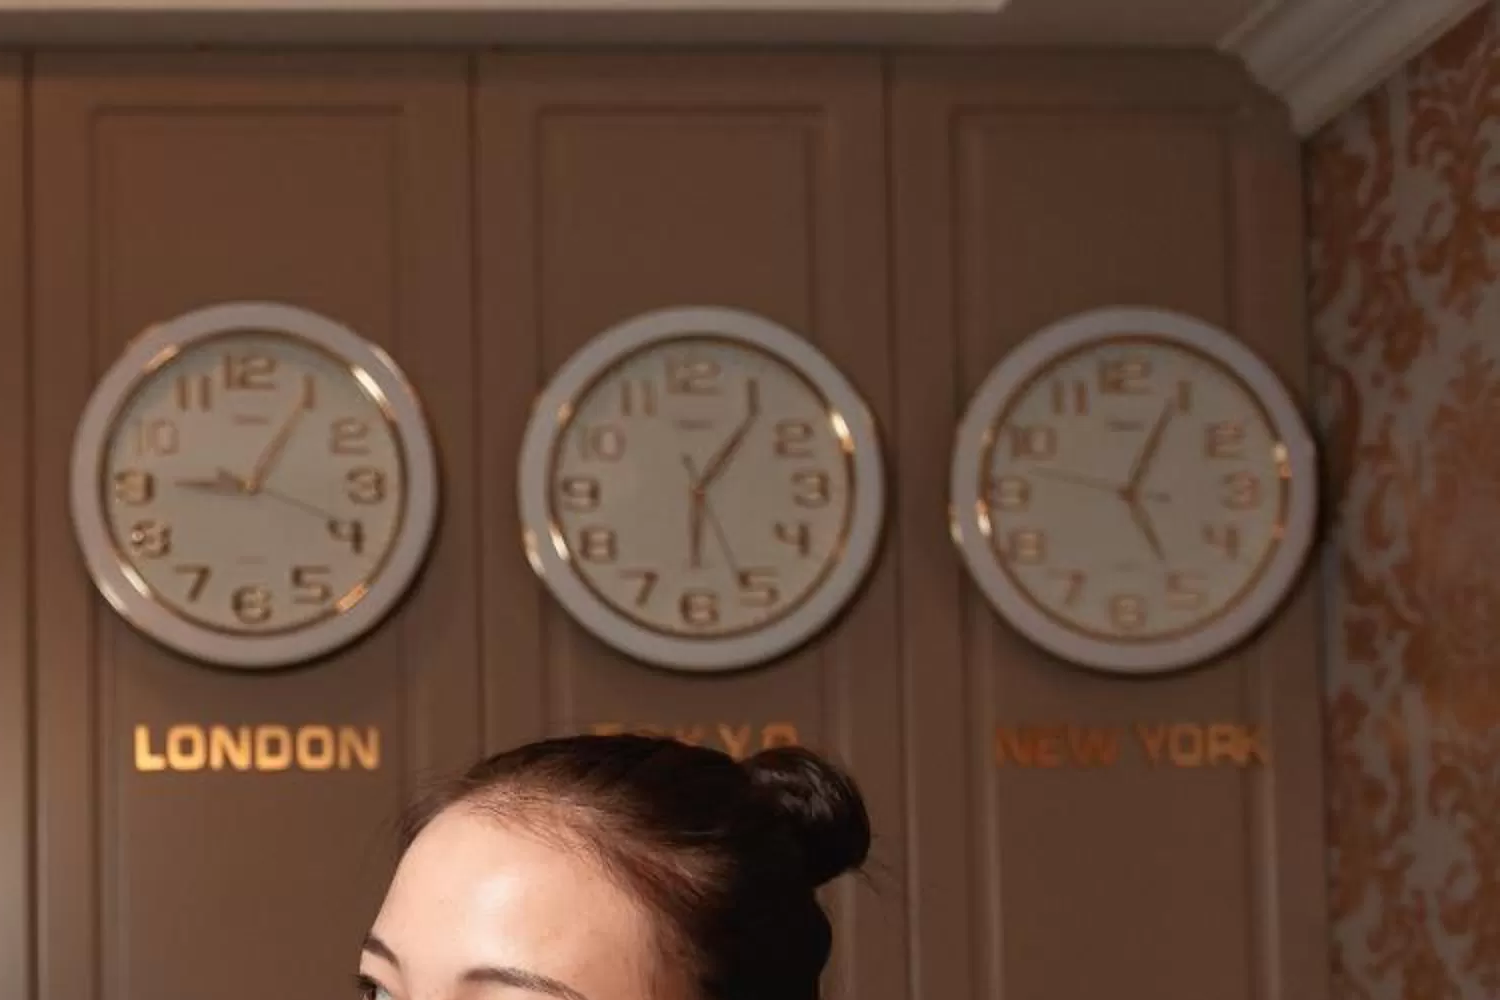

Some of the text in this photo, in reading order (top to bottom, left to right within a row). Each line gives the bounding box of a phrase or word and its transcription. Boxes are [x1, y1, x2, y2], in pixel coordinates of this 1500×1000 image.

[223, 355, 277, 390] 12
[666, 355, 721, 395] 12
[176, 376, 211, 412] 11
[304, 375, 315, 410] 1
[621, 380, 657, 416] 11
[746, 378, 758, 415] 1
[1052, 380, 1089, 416] 11
[1177, 379, 1191, 415] 1
[135, 419, 178, 456] 10
[331, 418, 370, 454] 2
[775, 421, 814, 459] 2
[345, 467, 385, 505] 3
[561, 475, 598, 511] 9
[791, 470, 829, 507] 3
[326, 519, 363, 554] 4
[580, 526, 617, 563] 8
[775, 521, 810, 556] 4
[1009, 529, 1045, 565] 8
[1205, 523, 1239, 560] 4
[174, 565, 211, 600] 7
[292, 565, 331, 603] 5
[620, 569, 659, 605] 7
[739, 567, 779, 606] 5
[1048, 569, 1086, 605] 7
[1166, 570, 1207, 609] 5
[232, 586, 271, 624] 6
[134, 724, 381, 771] LONDON
[995, 722, 1266, 769] NEW YORK
